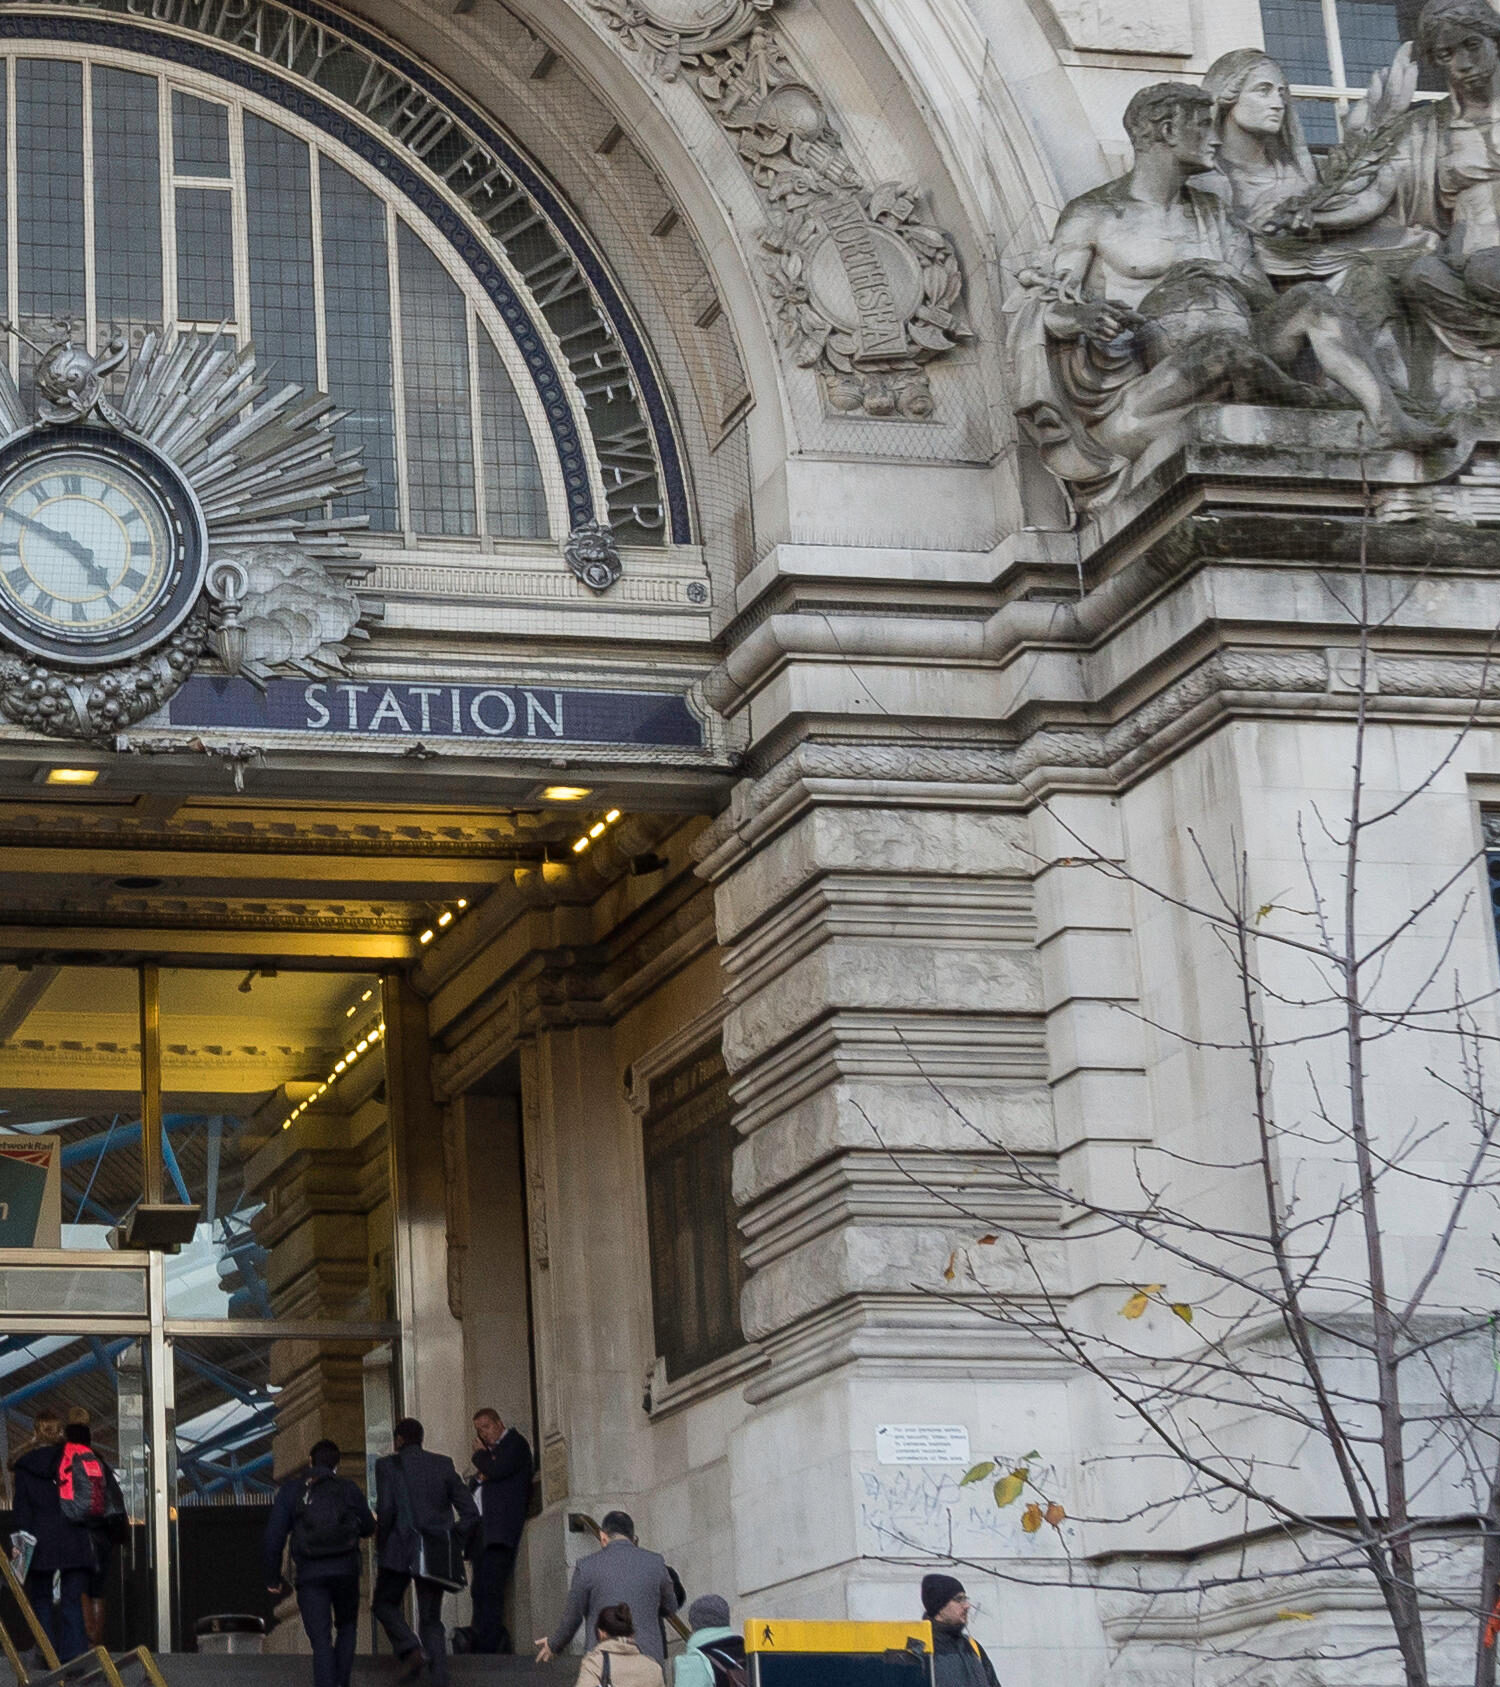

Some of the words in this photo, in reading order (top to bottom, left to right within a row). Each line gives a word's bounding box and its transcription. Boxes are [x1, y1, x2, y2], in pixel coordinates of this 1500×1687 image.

[354, 59, 454, 158] WHO
[441, 143, 545, 255] FELL
[523, 248, 589, 308] IN
[828, 198, 876, 294] NORTH
[856, 286, 901, 351] SEA
[560, 305, 637, 410] THE
[598, 423, 664, 529] WAR
[305, 681, 565, 738] STATION
